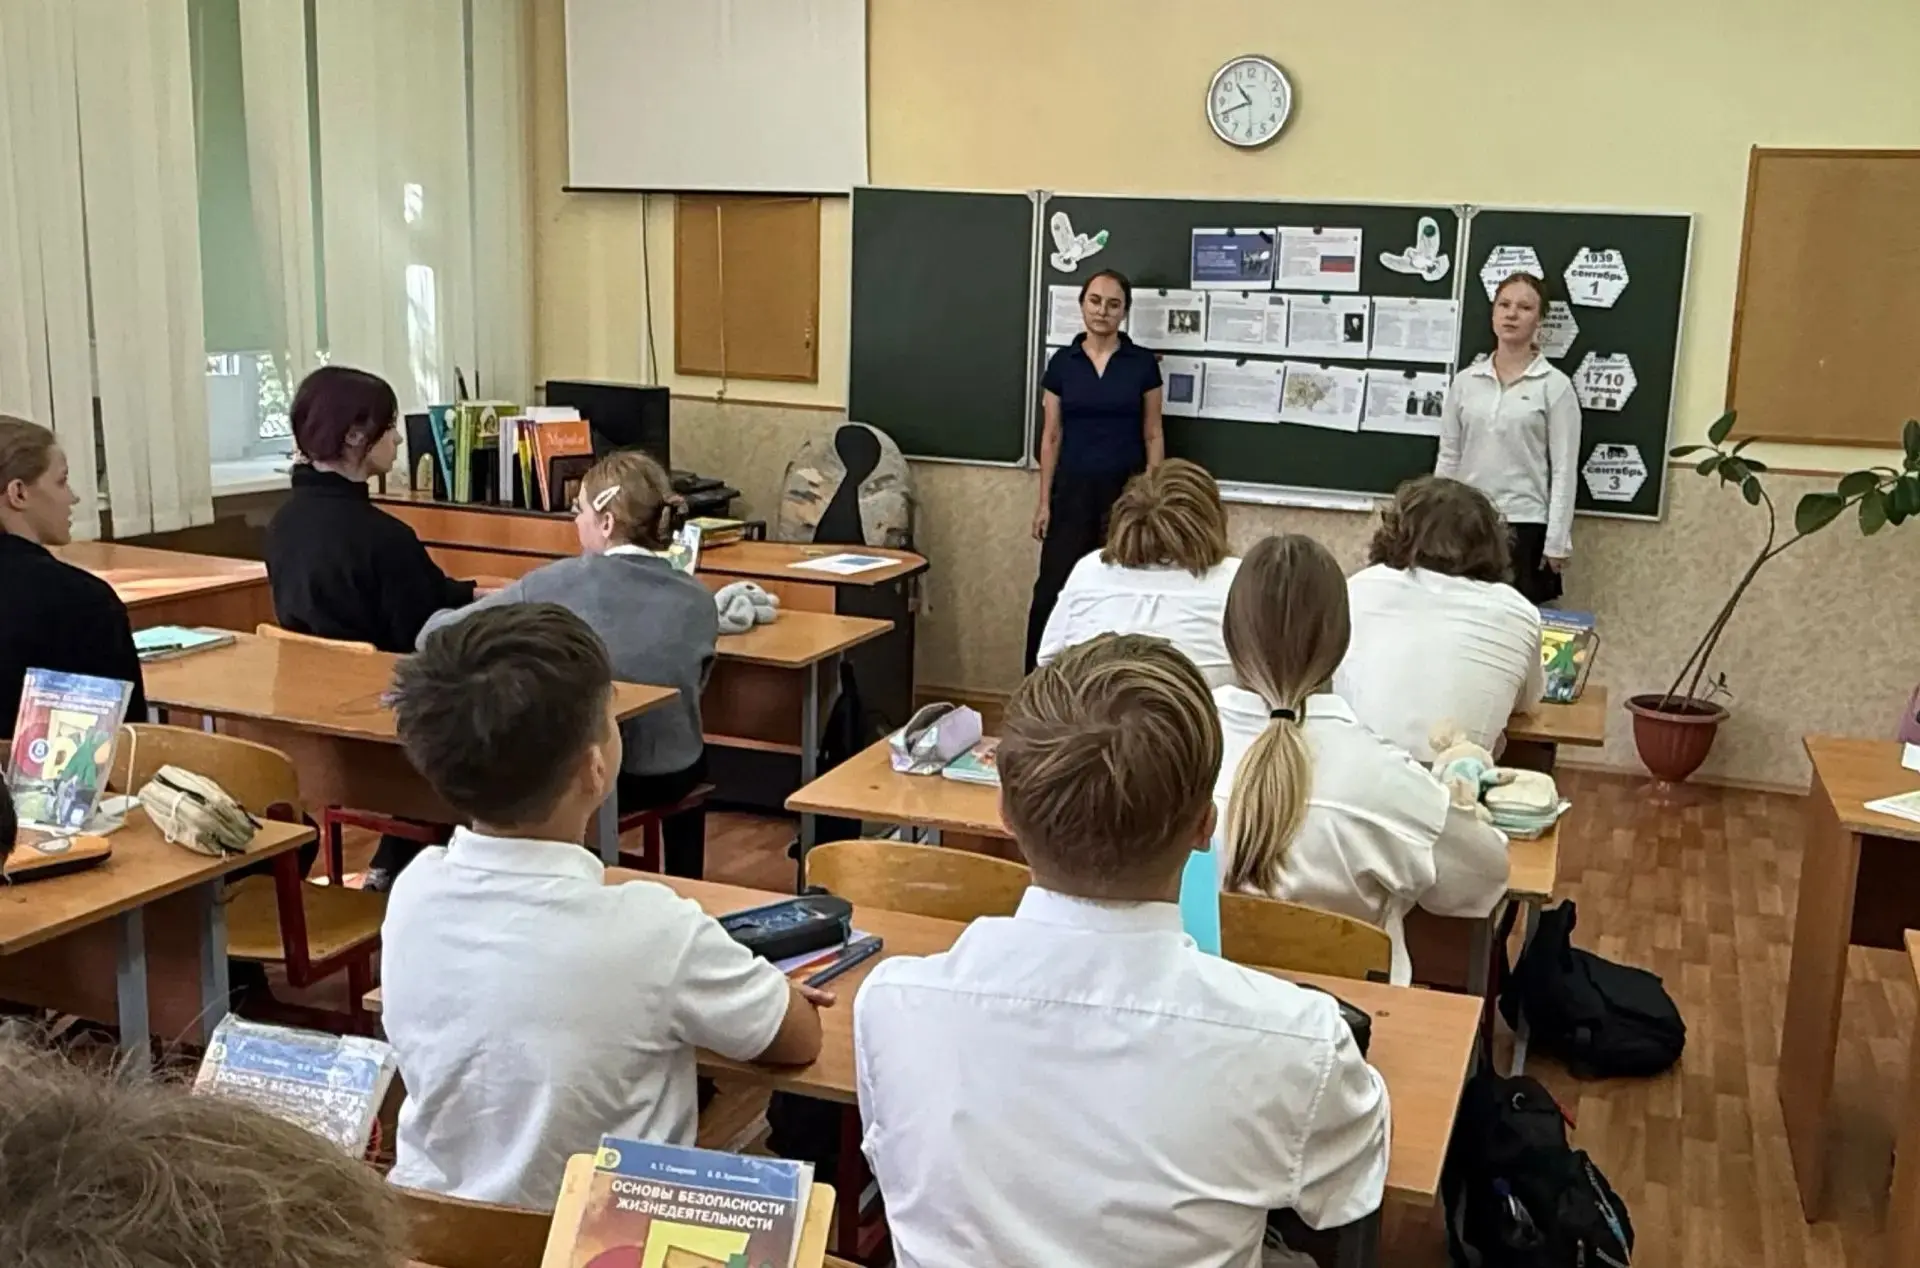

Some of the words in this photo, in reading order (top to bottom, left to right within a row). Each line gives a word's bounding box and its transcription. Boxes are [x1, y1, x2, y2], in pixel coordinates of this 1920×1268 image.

[1248, 67, 1256, 78] 12
[1223, 81, 1232, 92] 10
[1271, 80, 1280, 92] 2
[1275, 97, 1281, 108] 3
[1269, 113, 1276, 123] 4
[1232, 123, 1239, 136] 7
[1259, 122, 1267, 135] 5
[1584, 253, 1613, 263] 1939
[1571, 269, 1623, 282] сентябрь
[1589, 280, 1600, 296] 1
[1583, 371, 1625, 387] 1710
[1586, 466, 1643, 478] сентябрь
[1608, 475, 1621, 490] 3
[611, 1179, 674, 1200] ОСНОВЫ
[678, 1190, 785, 1216] БЕЗОПАСНОСТИ
[616, 1197, 773, 1231] ЖИЗНЕДЕЯТЕЛЬНОСТИ
